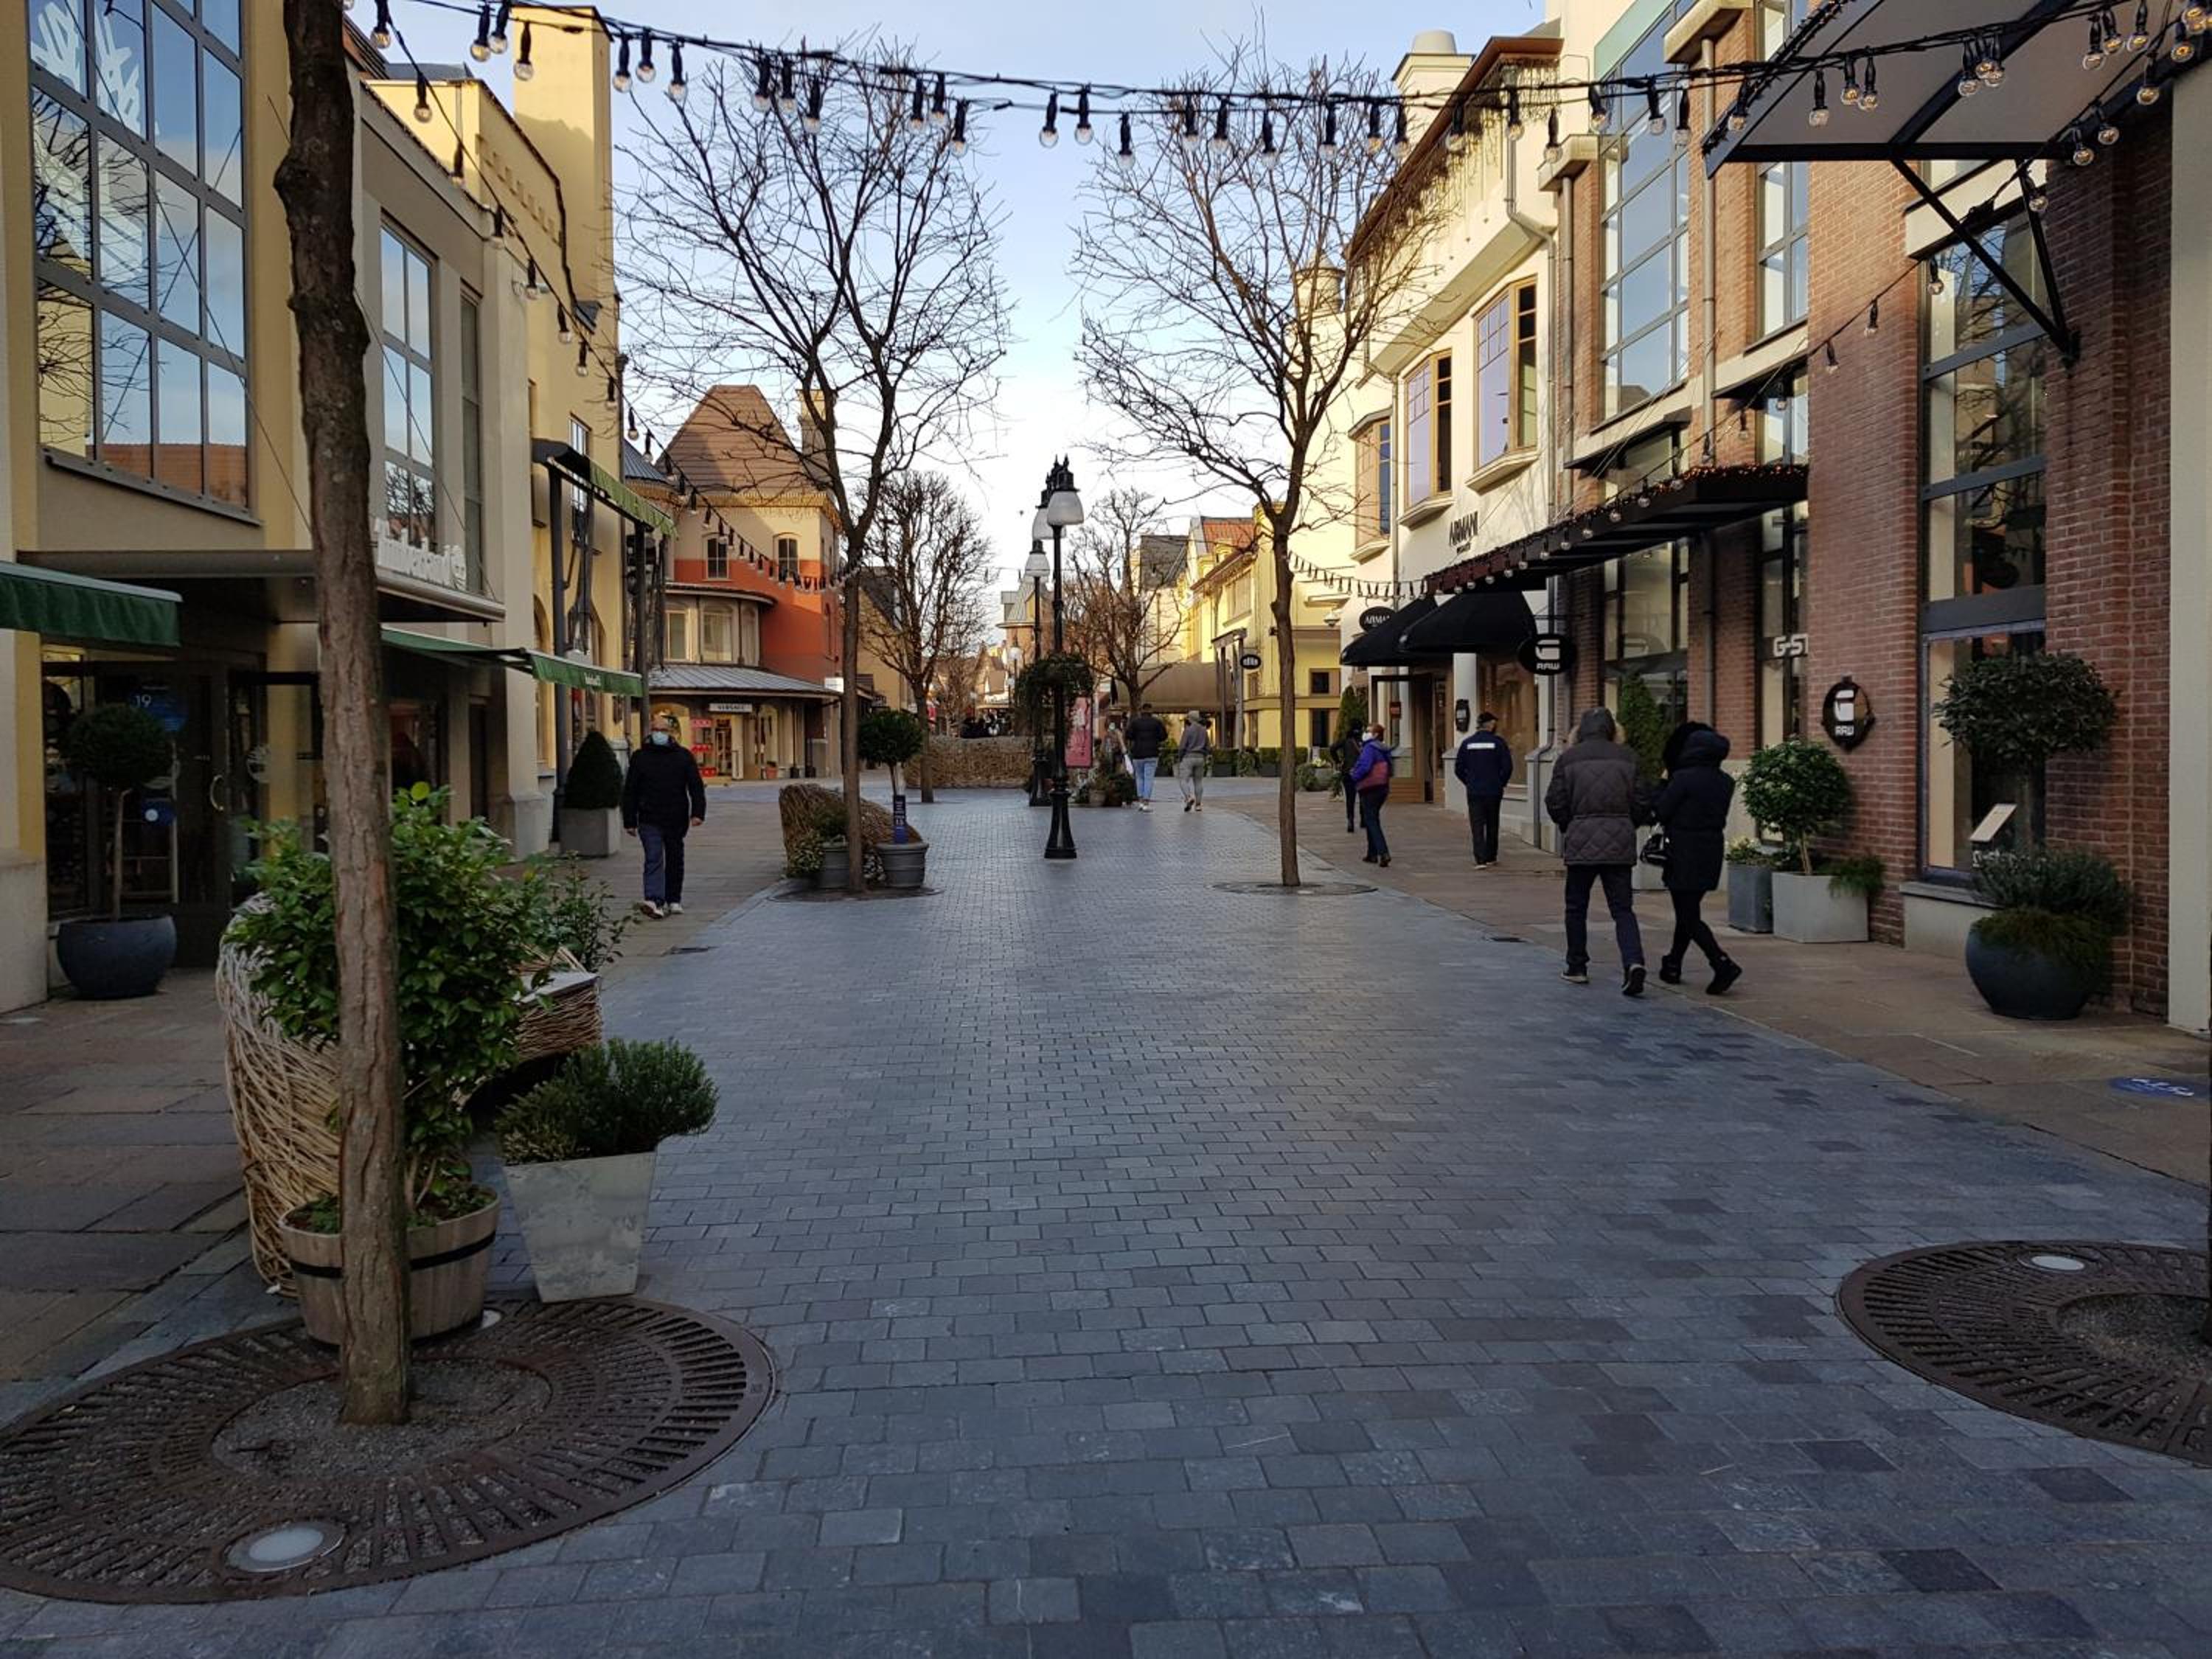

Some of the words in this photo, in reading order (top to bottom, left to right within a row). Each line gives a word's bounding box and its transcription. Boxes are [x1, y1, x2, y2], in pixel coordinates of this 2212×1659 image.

[1449, 510, 1478, 546] ARMANI
[1536, 662, 1560, 670] RAW
[1834, 725, 1854, 737] RAW
